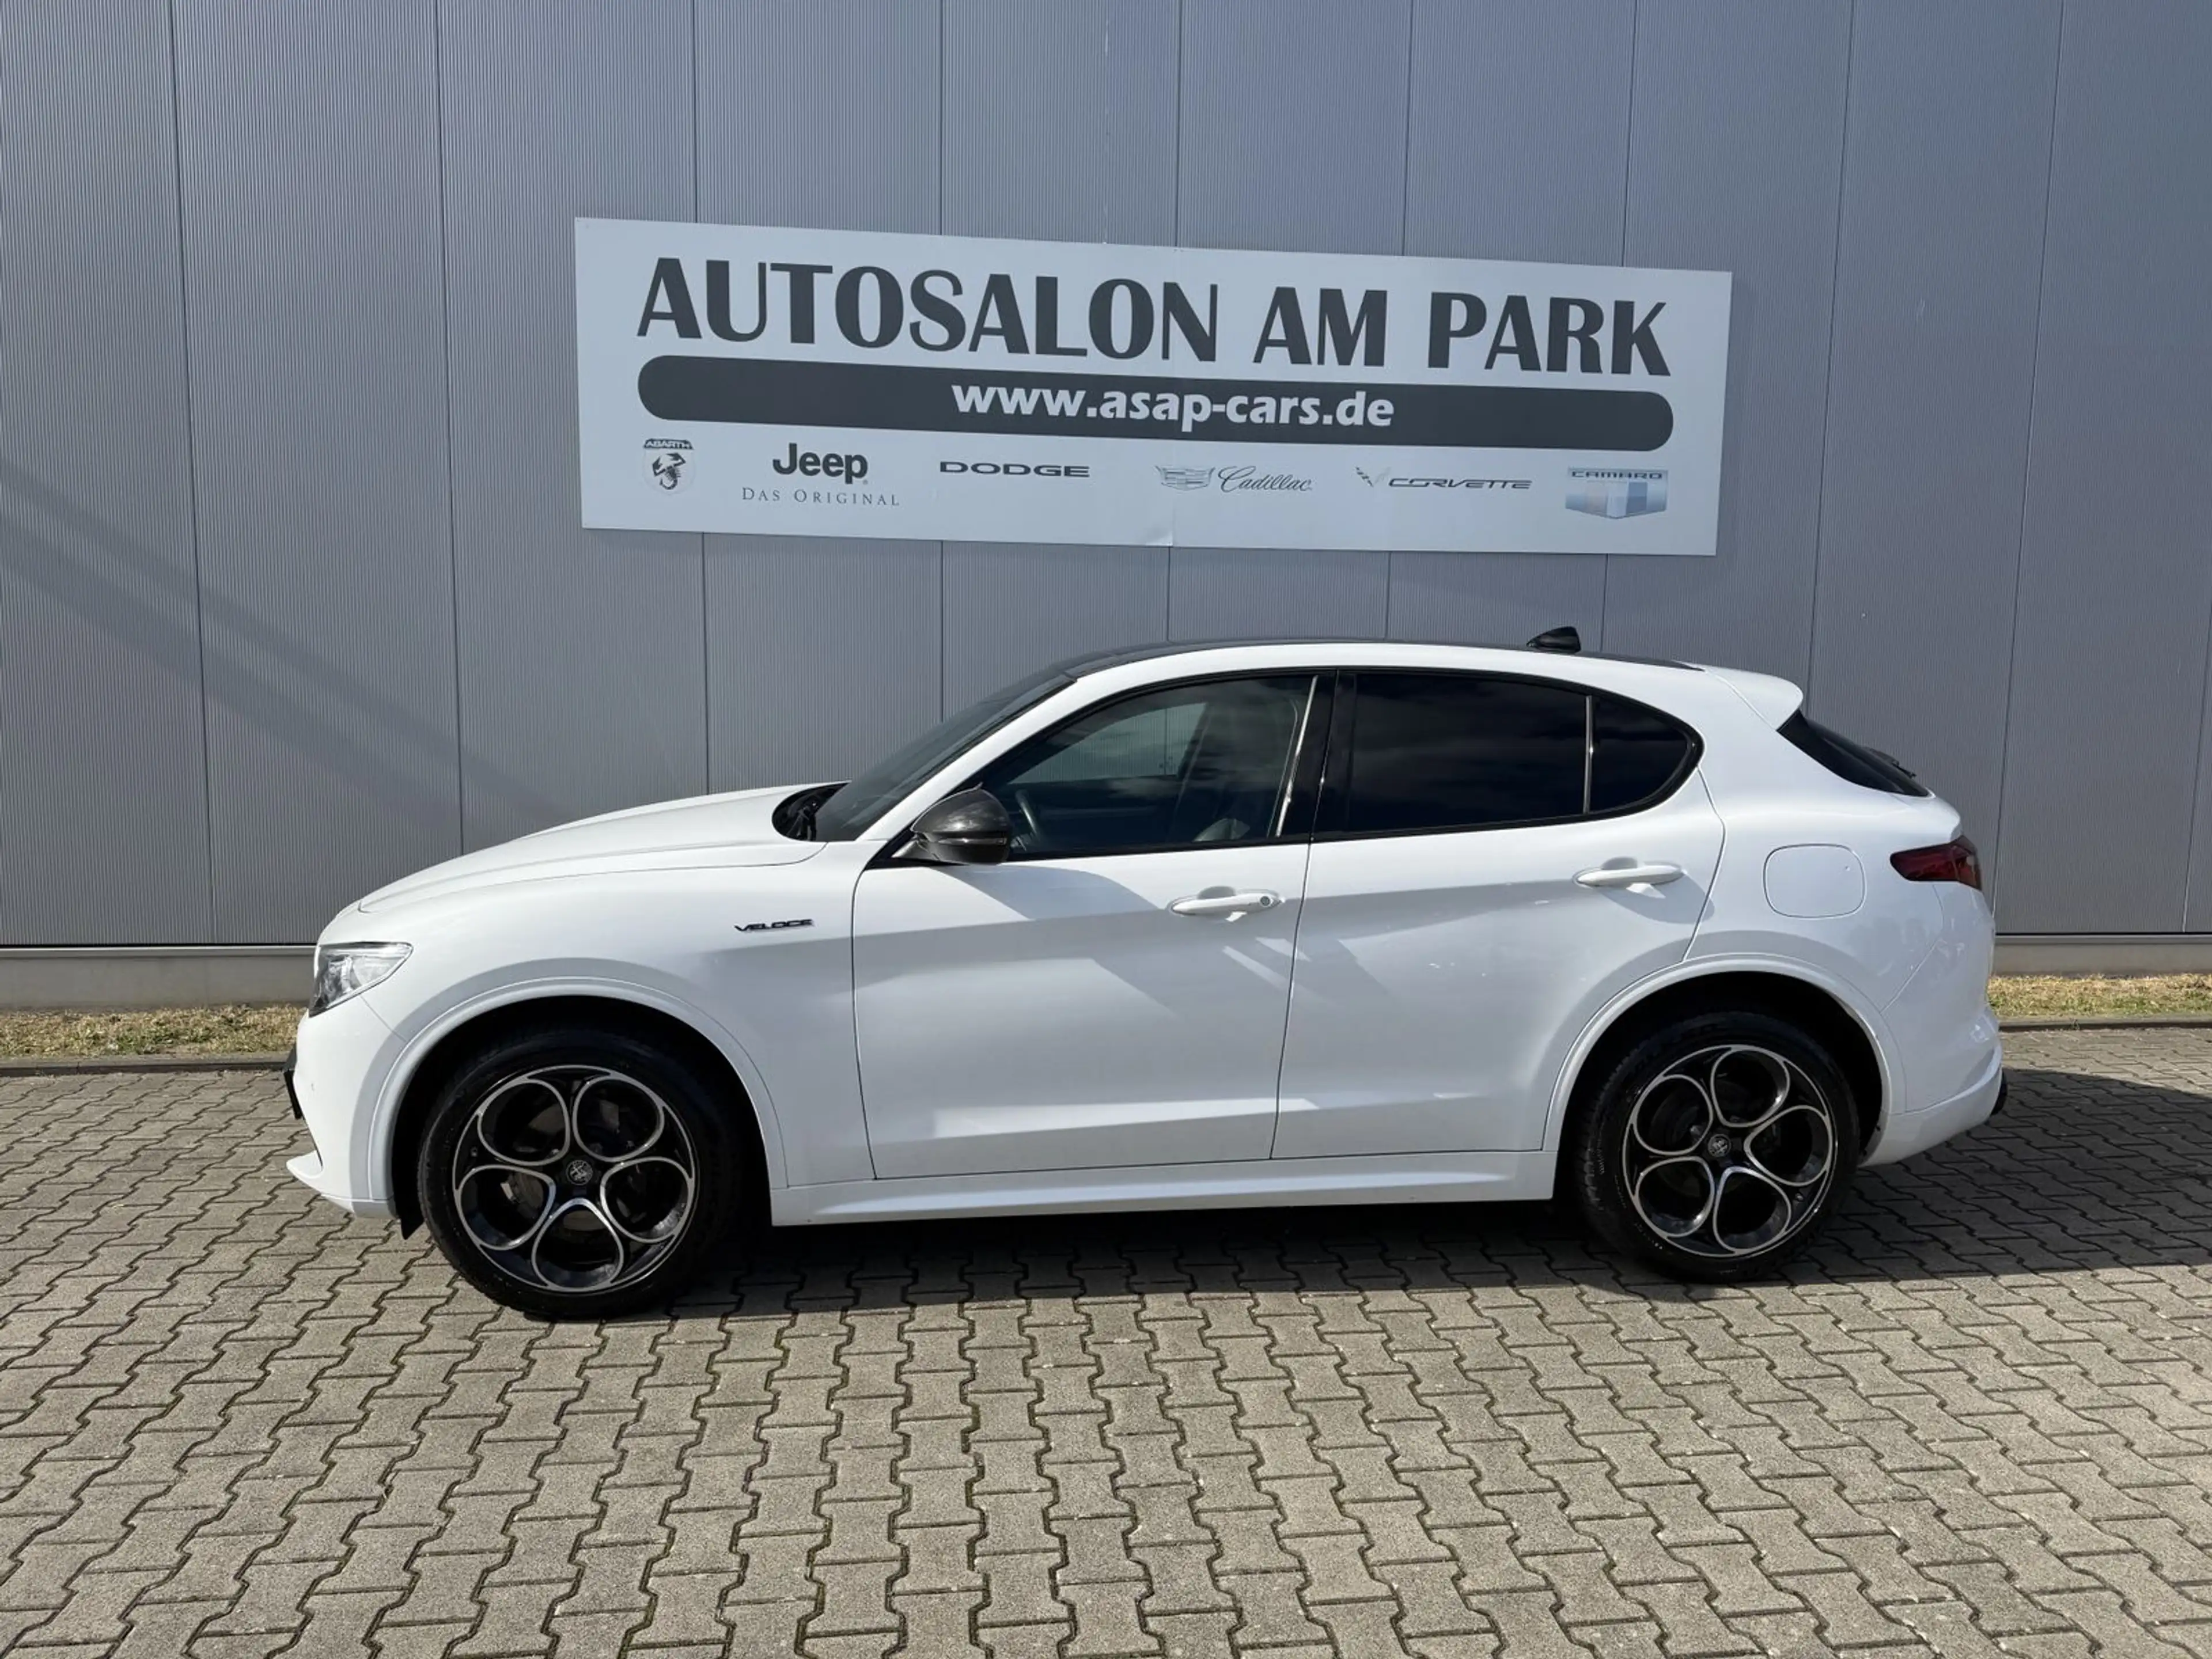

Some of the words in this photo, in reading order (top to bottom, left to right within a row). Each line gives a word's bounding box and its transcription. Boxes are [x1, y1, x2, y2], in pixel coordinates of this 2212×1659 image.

[637, 257, 1218, 362] AUTOSALON
[1253, 286, 1387, 367] AM
[1427, 291, 1671, 377] PARK
[951, 384, 1395, 433] www.asap-cars.de
[772, 442, 868, 484] Jeep
[940, 461, 1090, 478] DODGE
[1217, 465, 1312, 493] Cadillac
[1388, 478, 1533, 490] CORVETTE
[1571, 471, 1662, 479] CAMARO
[742, 487, 781, 502] DAS
[793, 488, 900, 506] ORIGINAL
[733, 918, 813, 932] VELOCE
